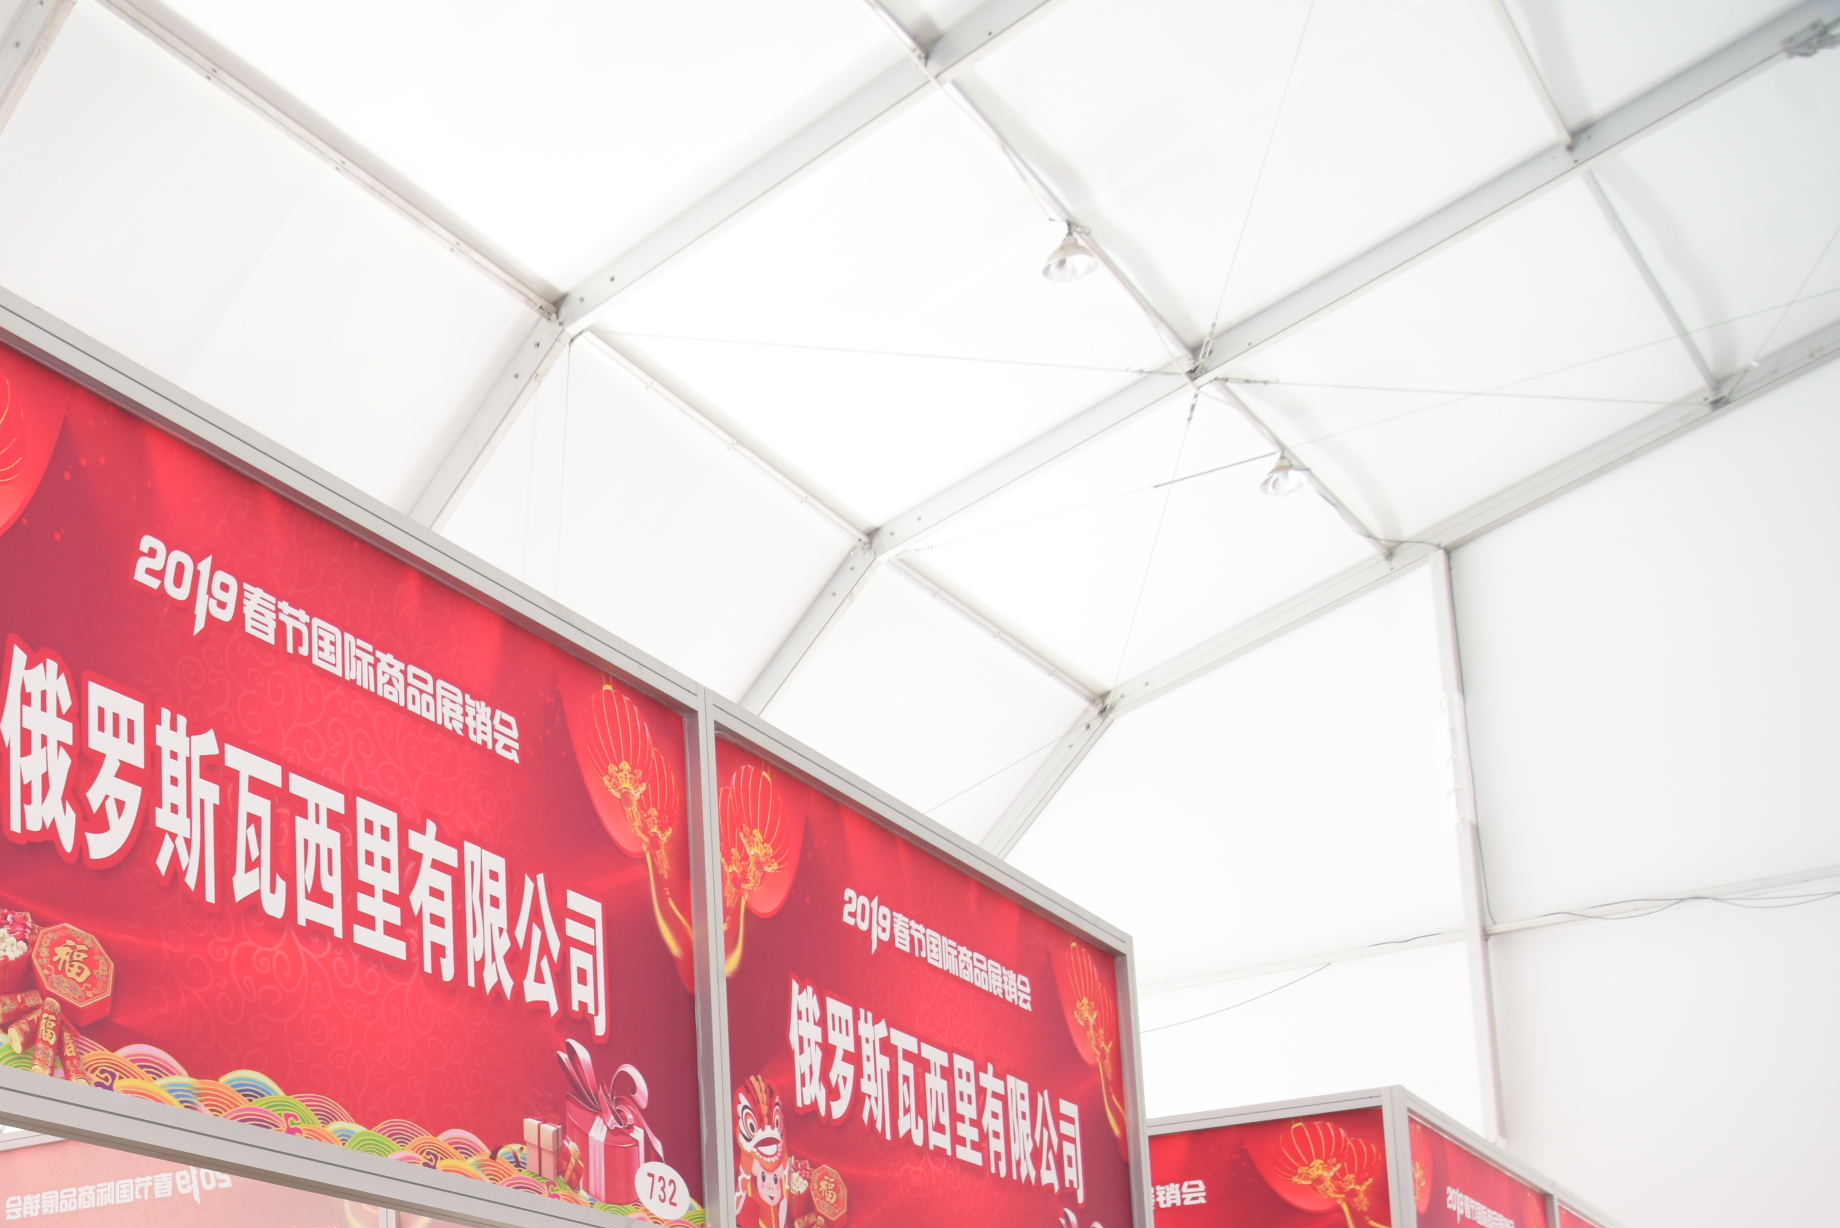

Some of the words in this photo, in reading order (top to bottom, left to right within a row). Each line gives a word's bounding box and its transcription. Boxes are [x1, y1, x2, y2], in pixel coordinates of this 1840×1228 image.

[134, 535, 521, 765] 2019春节国际商品展销会
[0, 644, 609, 1037] 俄罗斯瓦西里有限公司
[842, 887, 1033, 1012] 2019春节国际商品展销会
[646, 1171, 678, 1207] 732
[788, 978, 1085, 1204] 俄罗斯瓦西里有限公司
